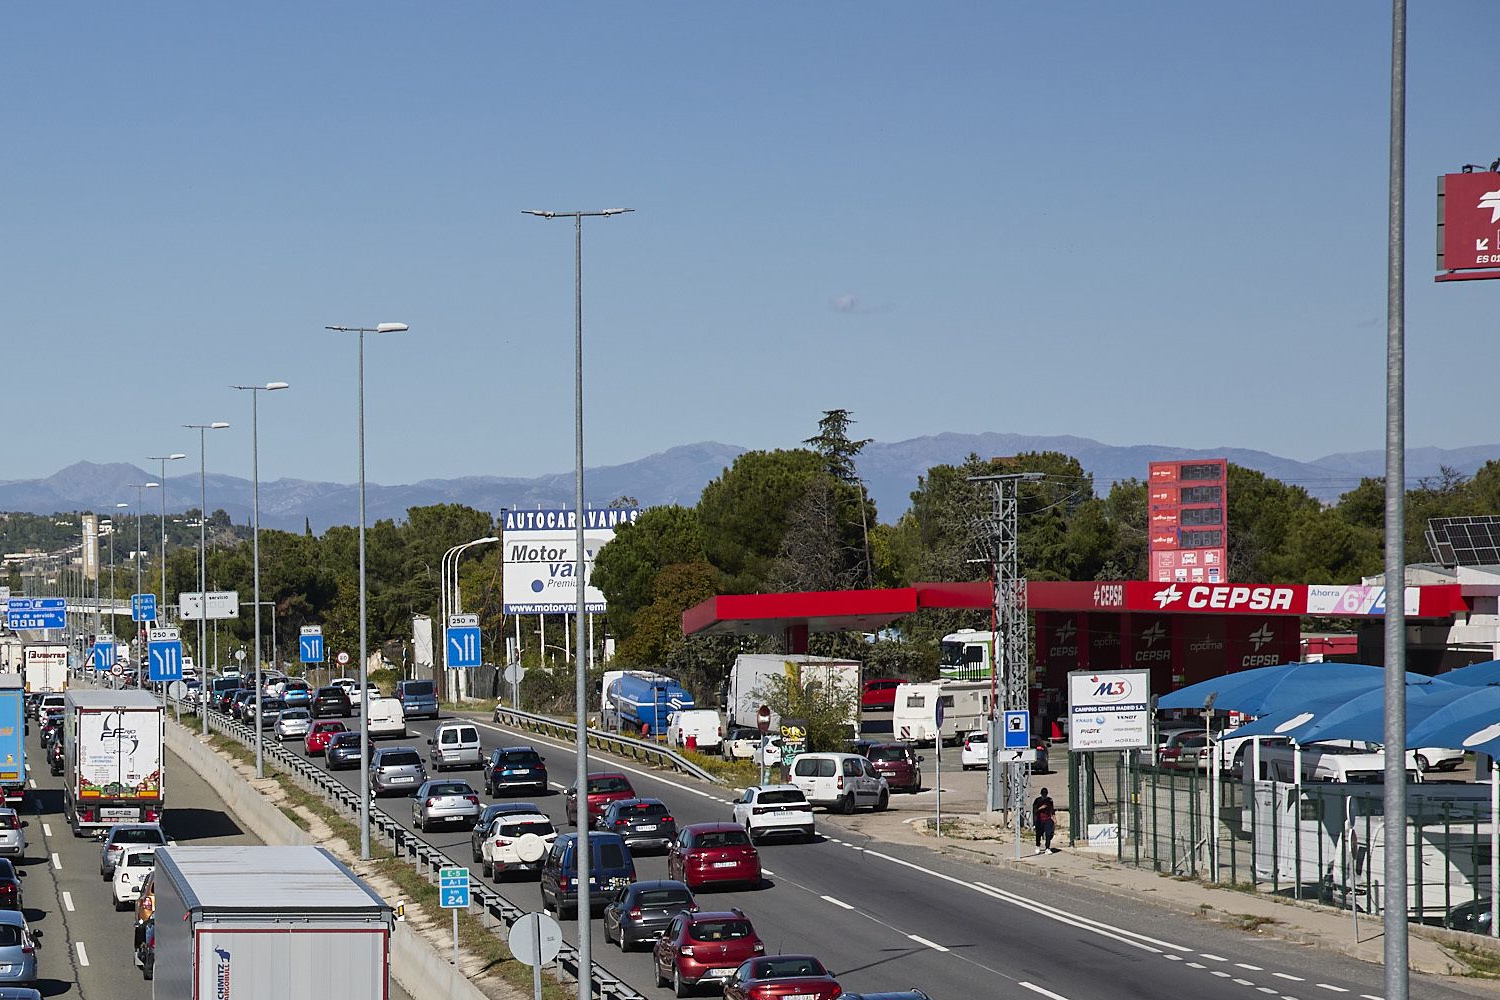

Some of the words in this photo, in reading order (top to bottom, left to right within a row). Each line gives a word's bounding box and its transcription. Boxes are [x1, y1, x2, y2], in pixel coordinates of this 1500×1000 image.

[511, 545, 567, 561] Motor
[1101, 584, 1123, 606] CEPSA
[1187, 586, 1295, 610] CEPSA
[1310, 588, 1340, 597] Ahorra
[1135, 650, 1171, 662] CEPSA
[1242, 654, 1280, 667] CEPSA
[1092, 681, 1125, 696] M3
[447, 895, 464, 905] 24
